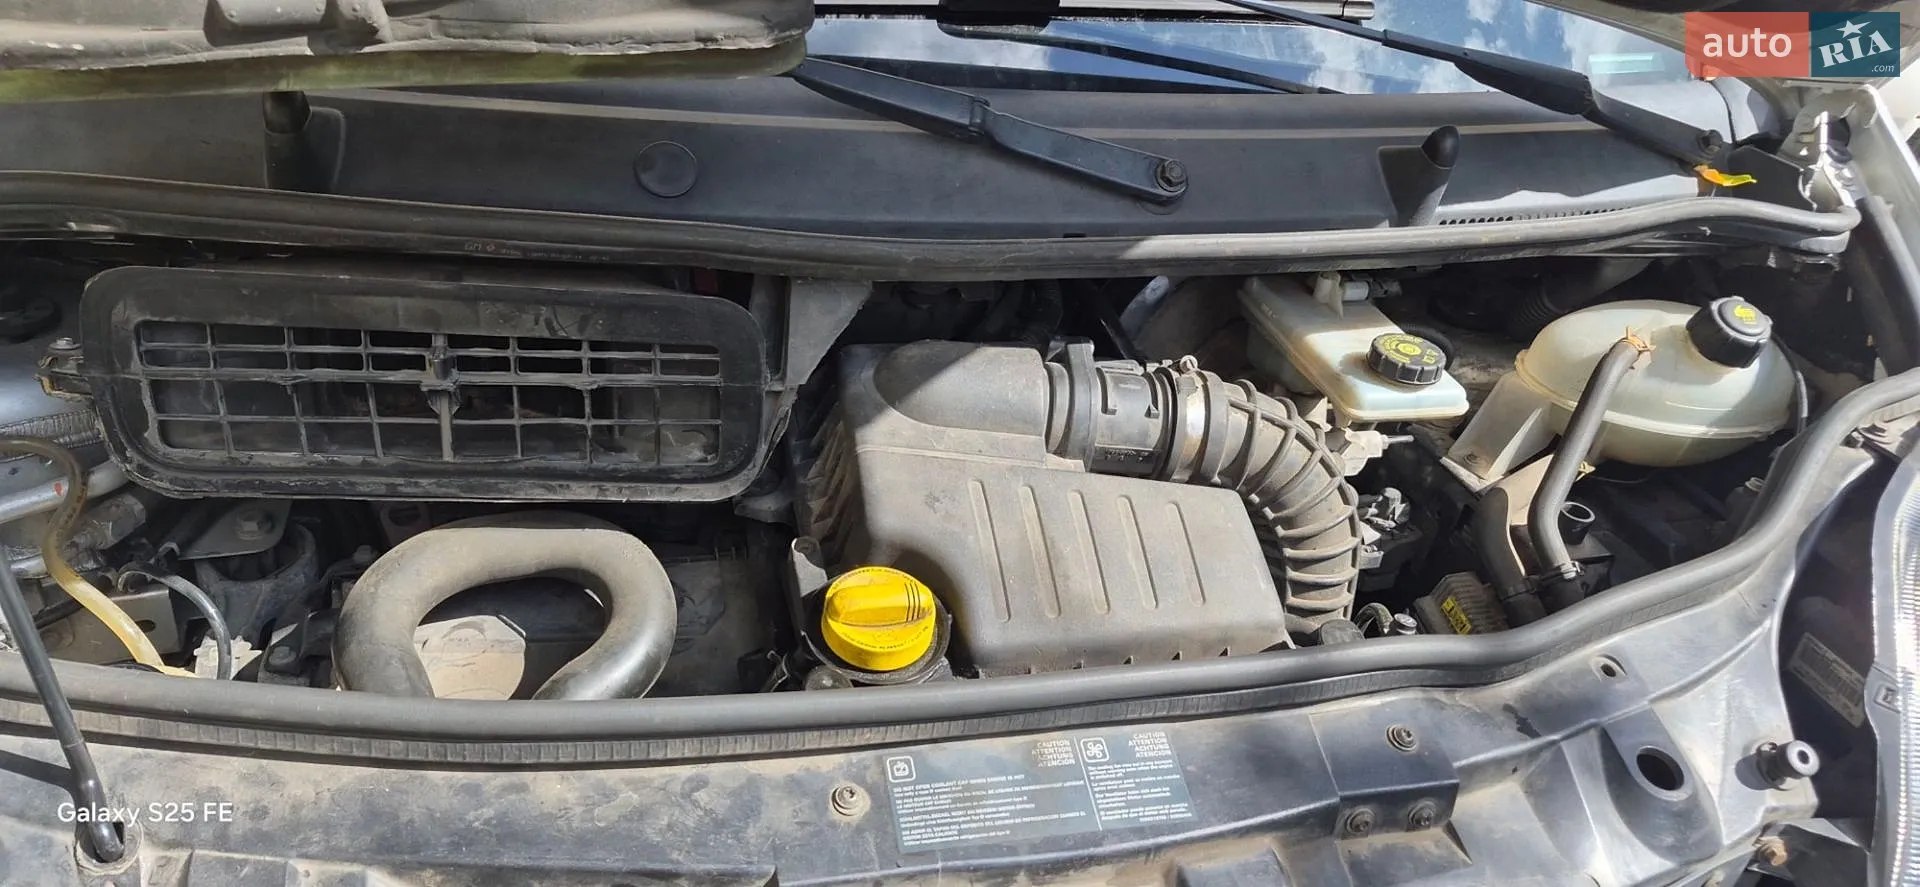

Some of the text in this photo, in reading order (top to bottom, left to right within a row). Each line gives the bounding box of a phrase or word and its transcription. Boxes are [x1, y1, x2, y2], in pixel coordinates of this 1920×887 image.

[1134, 731, 1166, 740] CAUTION
[1037, 739, 1071, 748] CAUTION
[1128, 737, 1168, 747] ATTENTION
[1031, 746, 1073, 755] ATTENTION
[1135, 744, 1170, 753] ACHTUNG
